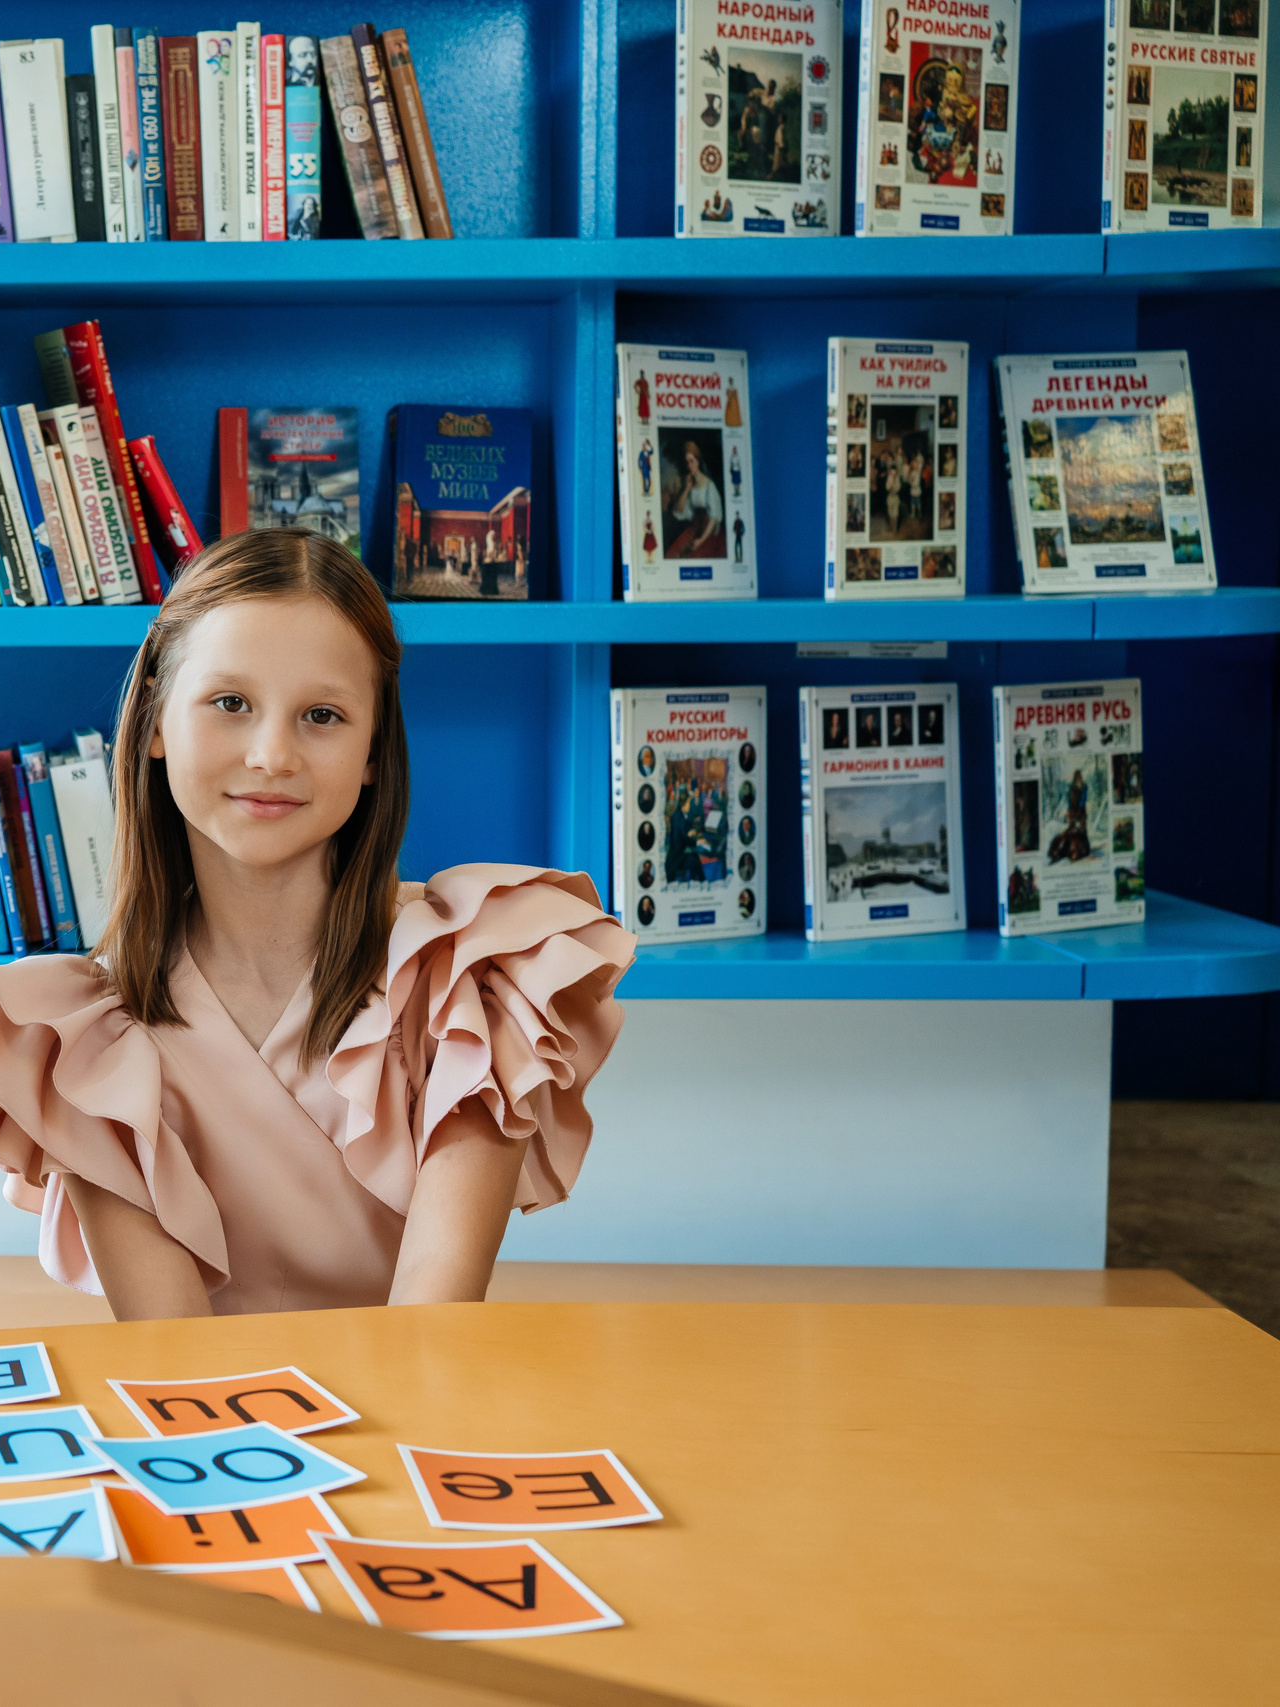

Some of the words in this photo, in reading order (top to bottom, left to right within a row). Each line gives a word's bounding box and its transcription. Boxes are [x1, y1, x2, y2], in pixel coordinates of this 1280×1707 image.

[718, 1, 815, 23] НАРОДНЫЙ
[906, 0, 989, 19] НАРОДНЫЕ
[717, 23, 815, 46] КАЛЕНДАРЬ
[903, 18, 991, 40] ПРОМЫСЛЫ
[19, 51, 35, 63] 83
[245, 35, 256, 60] ВЕКА
[1132, 42, 1195, 63] РУССКИЕ
[1201, 48, 1256, 67] СВЯТЫЕ
[360, 45, 380, 77] ВЕКА
[141, 87, 157, 114] МНЕ
[369, 81, 385, 99] XX
[219, 103, 227, 121] ДЛЯ
[246, 83, 256, 145] ЛИТЕРАТУРА
[340, 105, 372, 143] 69
[142, 115, 159, 140] ОБО
[373, 101, 399, 160] ПИСАТЕЛИ
[219, 123, 227, 173] ЛИТЕРАТУРА
[264, 109, 282, 177] НУМЕРАЦИЯ
[27, 102, 46, 211] Литературоведение
[144, 156, 162, 181] СОН
[289, 153, 317, 177] 55
[246, 151, 256, 194] РУССКАЯ
[267, 179, 281, 188] С
[388, 164, 412, 221] ВЕЛИКИЕ
[267, 190, 283, 233] ХВОСТА
[860, 357, 886, 372] КАК
[890, 357, 948, 373] УЧИЛИСЬ
[655, 372, 722, 390] РУССКИЙ
[876, 374, 893, 388] НА
[899, 374, 931, 389] РУСИ
[1047, 375, 1148, 393] ЛЕГЕНДЫ
[656, 393, 722, 410] КОСТЮМ
[1032, 394, 1114, 413] ДРЕВНЕЙ
[1121, 394, 1167, 409] РУСИ
[268, 414, 336, 427] ИСТОРИЯ
[425, 443, 506, 464] ВЕЛИКИХ
[73, 454, 92, 491] МИР
[91, 457, 109, 492] МИР
[431, 462, 498, 481] МУЗЕЕВ
[438, 481, 490, 500] МИРА
[83, 494, 111, 568] ПОЗНАЮ
[101, 496, 129, 565] ПОЗНАЮ
[100, 570, 117, 585] Я
[118, 567, 133, 581] Я
[669, 710, 726, 724] РУССКИЕ
[1014, 701, 1086, 730] ДРЕВНЯЯ
[1092, 699, 1131, 721] РУСЬ
[646, 727, 748, 743] КОМПОЗИТОРЫ
[71, 768, 86, 781] 88
[823, 758, 889, 774] ГАРМОНИЯ
[893, 757, 901, 770] В
[905, 755, 945, 770] КАМНЕ
[146, 1388, 320, 1424] Uu
[139, 1447, 305, 1483] Oo
[440, 1471, 615, 1511] Ee
[357, 1561, 537, 1611] Aa
